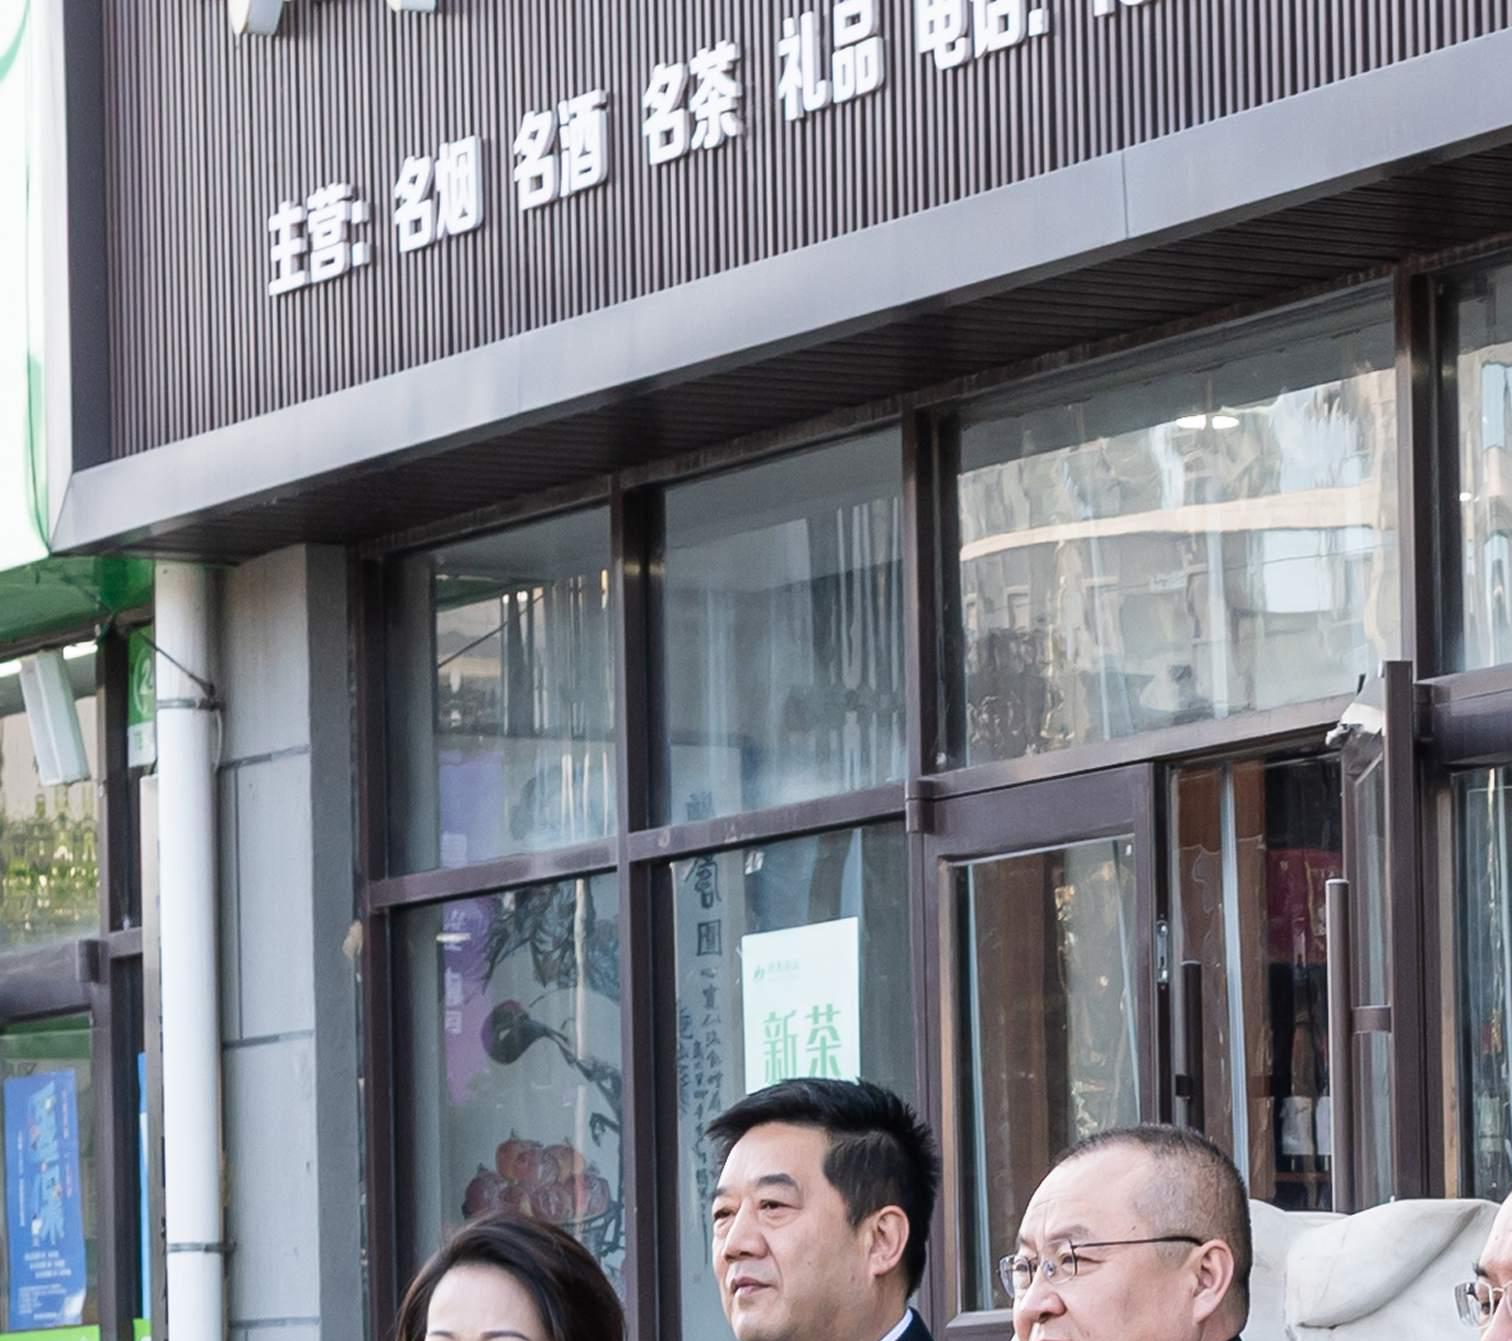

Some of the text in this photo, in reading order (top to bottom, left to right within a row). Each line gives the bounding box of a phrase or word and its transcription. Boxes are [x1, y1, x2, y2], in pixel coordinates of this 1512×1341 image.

[268, 183, 370, 297] 主营：
[394, 135, 482, 253] 名烟
[513, 88, 610, 211] 名酒
[641, 39, 744, 166] 名茶
[778, 0, 886, 121] 礼品
[763, 1002, 843, 1086] 新茶
